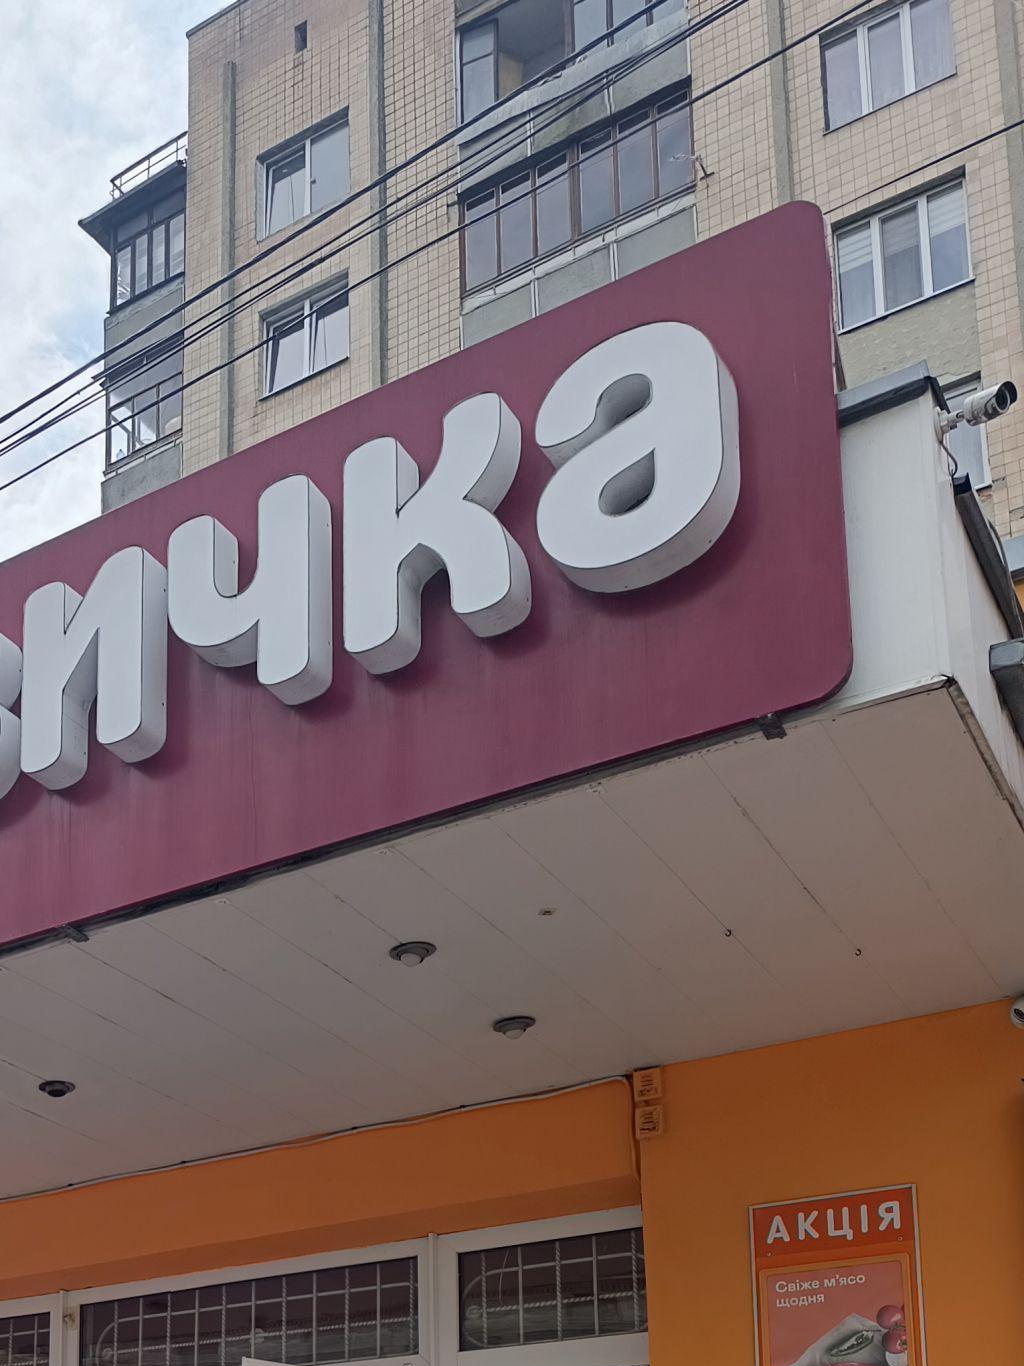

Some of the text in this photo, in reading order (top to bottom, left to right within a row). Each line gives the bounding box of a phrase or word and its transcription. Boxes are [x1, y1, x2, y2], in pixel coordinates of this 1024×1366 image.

[766, 1200, 901, 1244] АКЦІЯ
[775, 1274, 866, 1293] Свіже м'ясо
[776, 1294, 825, 1308] щодня
